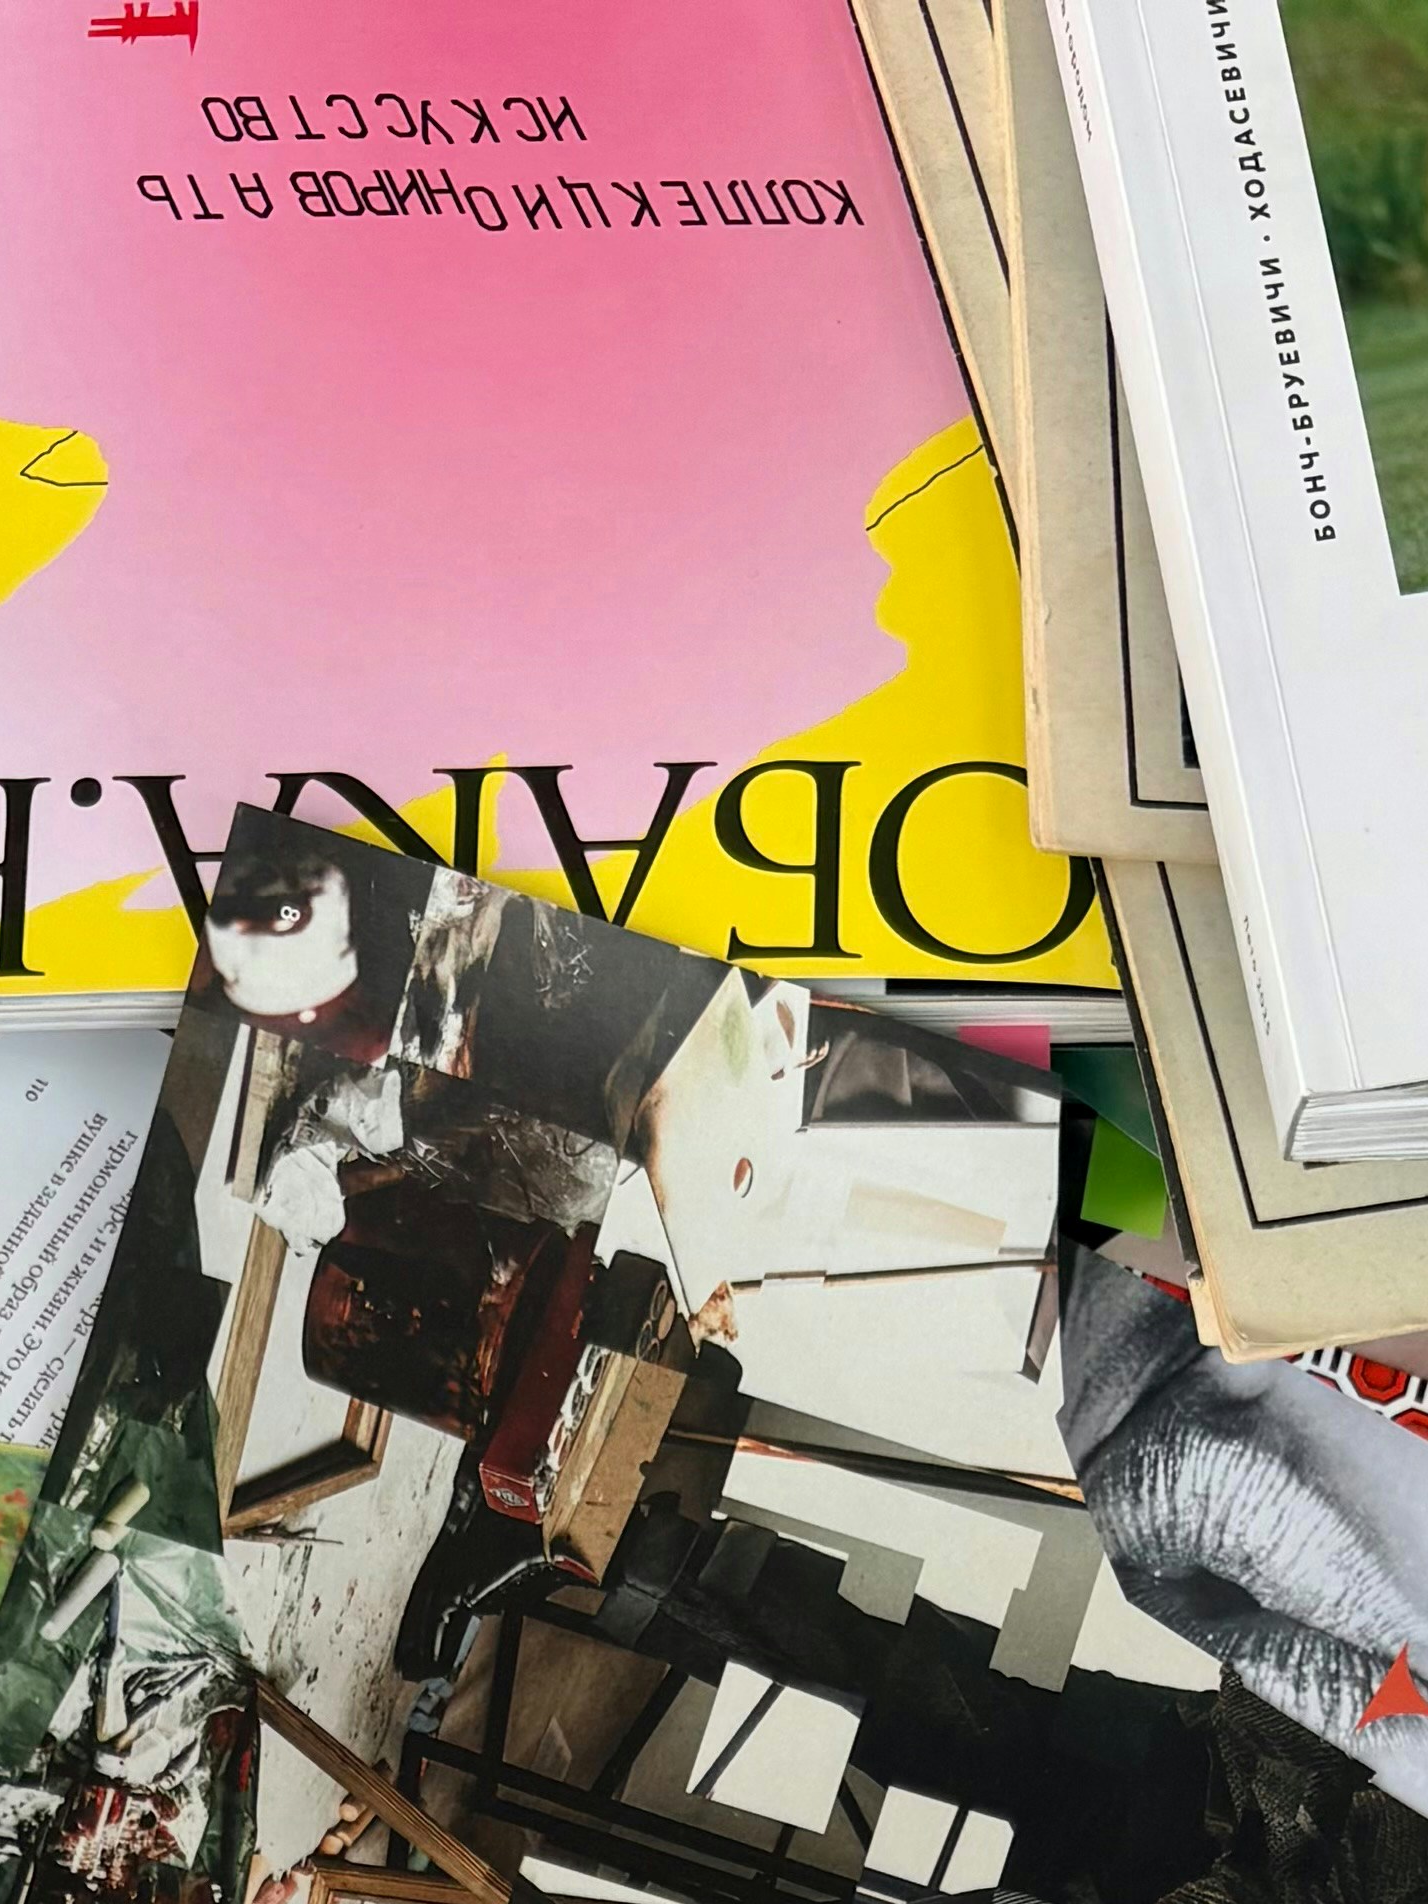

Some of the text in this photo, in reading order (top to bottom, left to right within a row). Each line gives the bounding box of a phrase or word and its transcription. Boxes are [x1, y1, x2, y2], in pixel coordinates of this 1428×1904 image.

[1258, 256, 1337, 542] БОНЧ-БРУЕВИЧИ
[38, 1129, 139, 1266] гармоничный
[9, 1334, 44, 1374] Это
